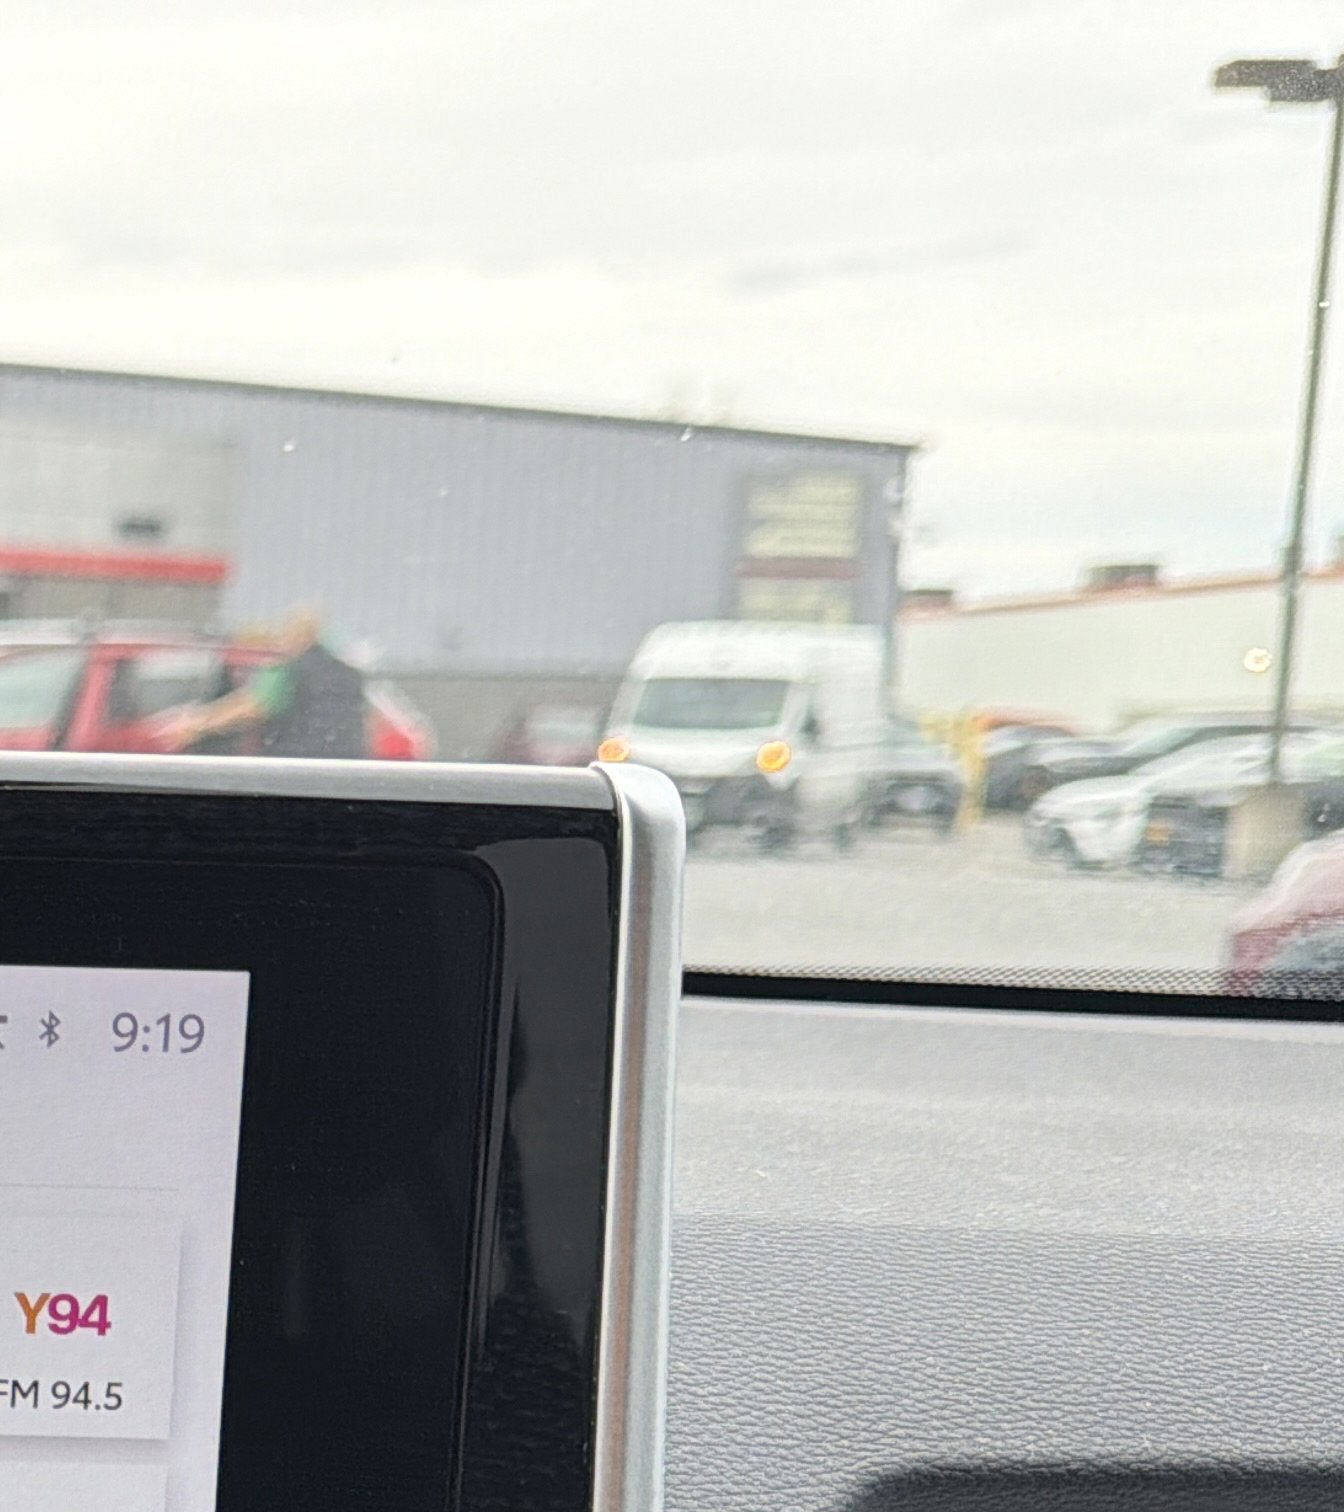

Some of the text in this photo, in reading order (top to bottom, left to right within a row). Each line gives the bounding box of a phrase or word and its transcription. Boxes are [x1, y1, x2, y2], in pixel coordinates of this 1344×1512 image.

[112, 1011, 205, 1054] 9:19
[14, 1291, 112, 1337] Y94
[50, 1380, 123, 1411] 94.5
